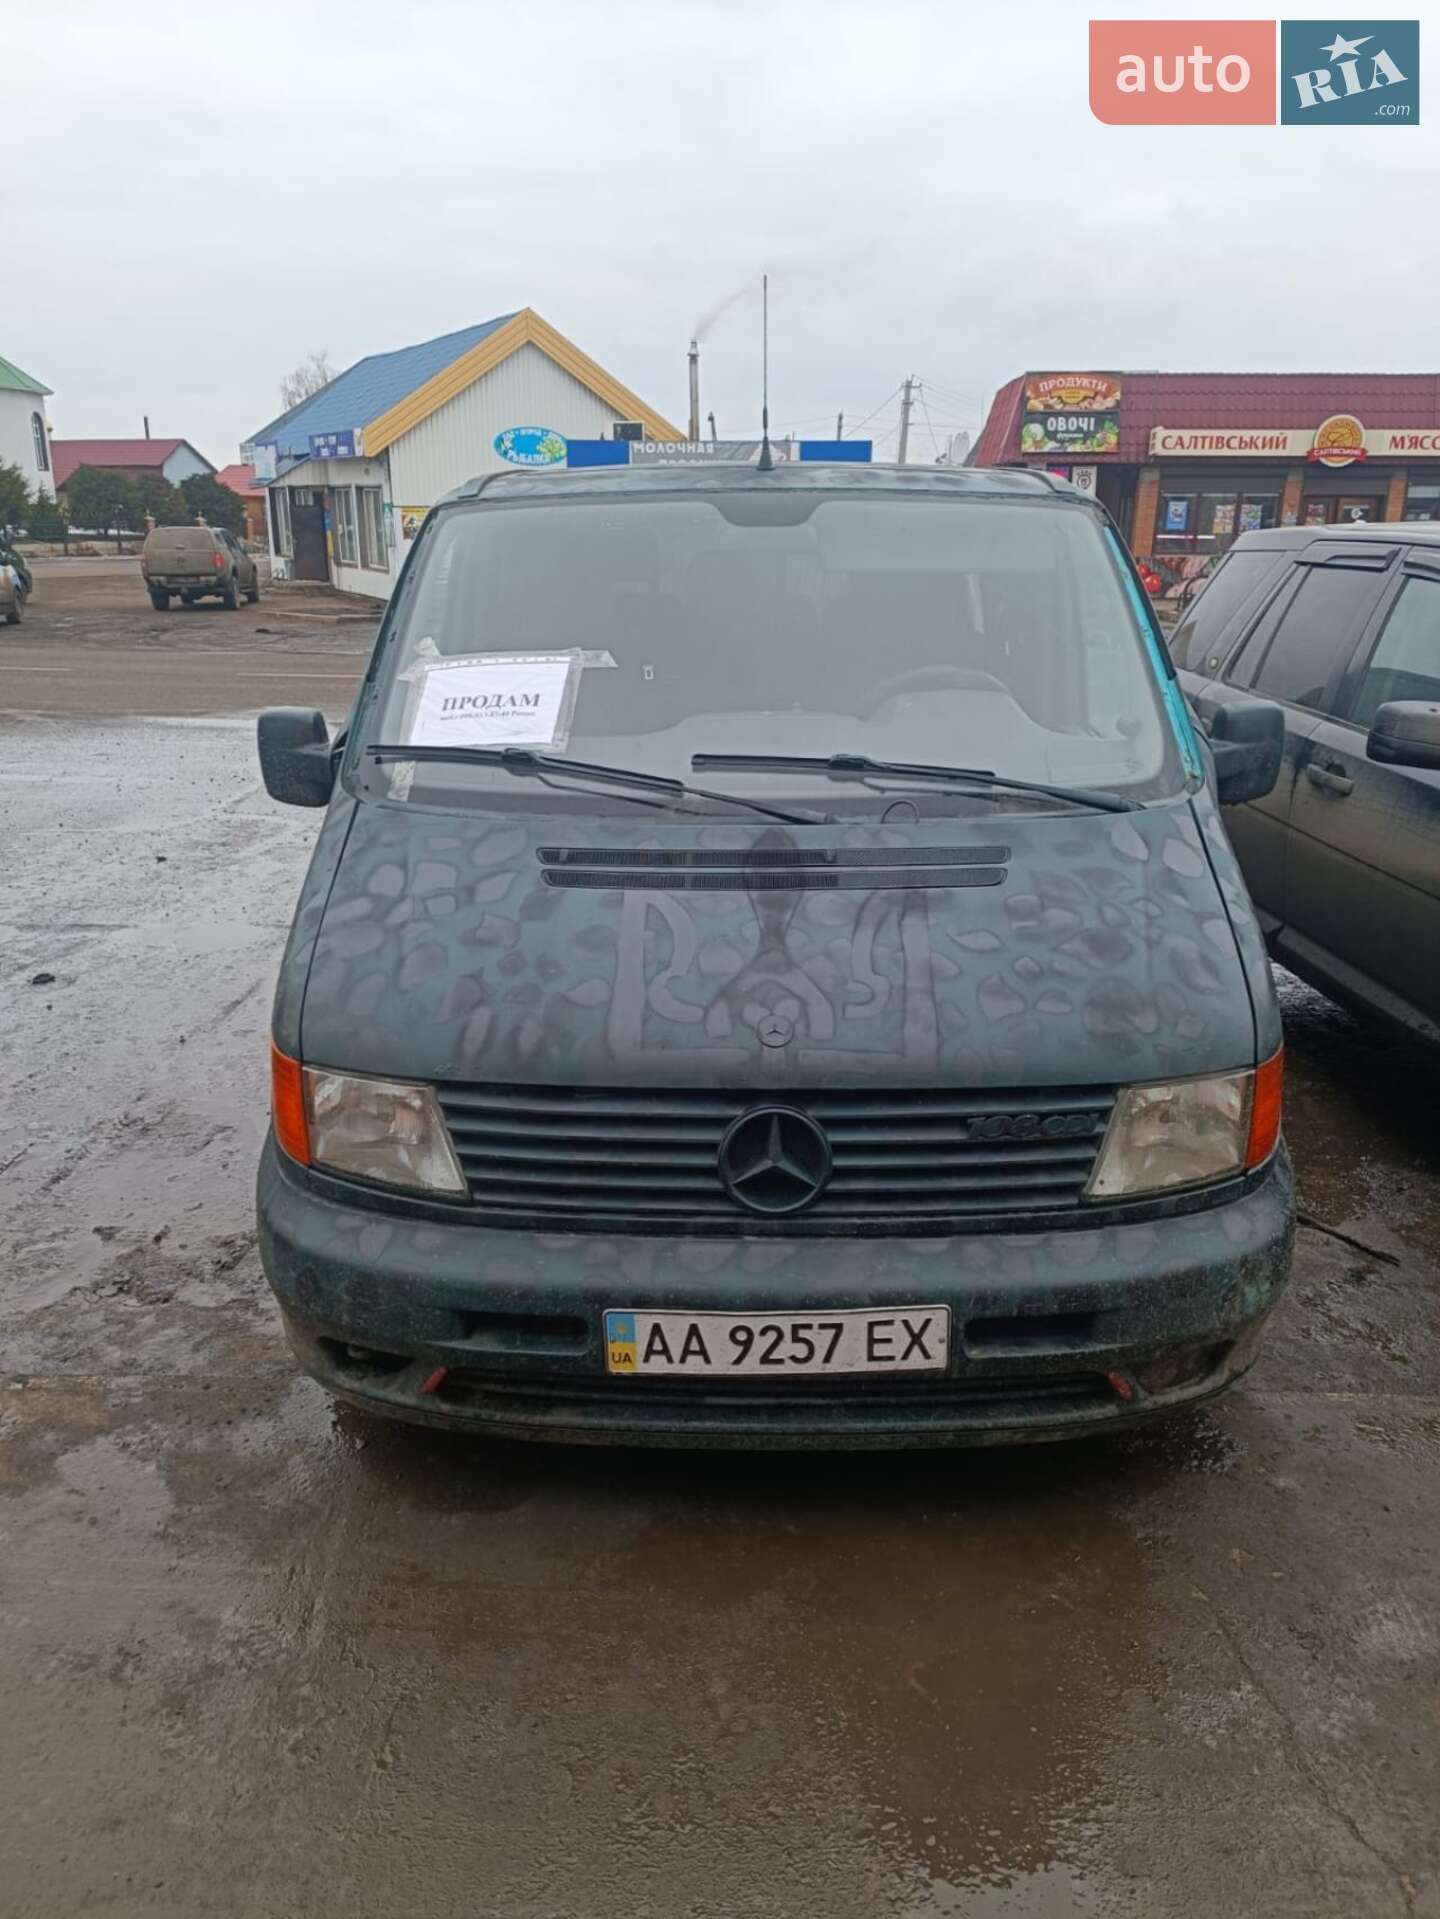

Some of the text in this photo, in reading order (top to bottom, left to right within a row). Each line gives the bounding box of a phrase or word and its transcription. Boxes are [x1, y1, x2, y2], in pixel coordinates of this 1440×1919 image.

[1039, 377, 1108, 392] ПРОДУКТИ
[1047, 416, 1095, 431] ОВОЧІ
[633, 442, 715, 455] МОЛОЧНАЯ
[1161, 432, 1288, 450] САЛТІВСЬКИЙ
[442, 693, 540, 711] ПРОДАМ
[728, 1322, 844, 1366] 9257
[866, 1317, 933, 1363] EX
[612, 1351, 633, 1364] UA
